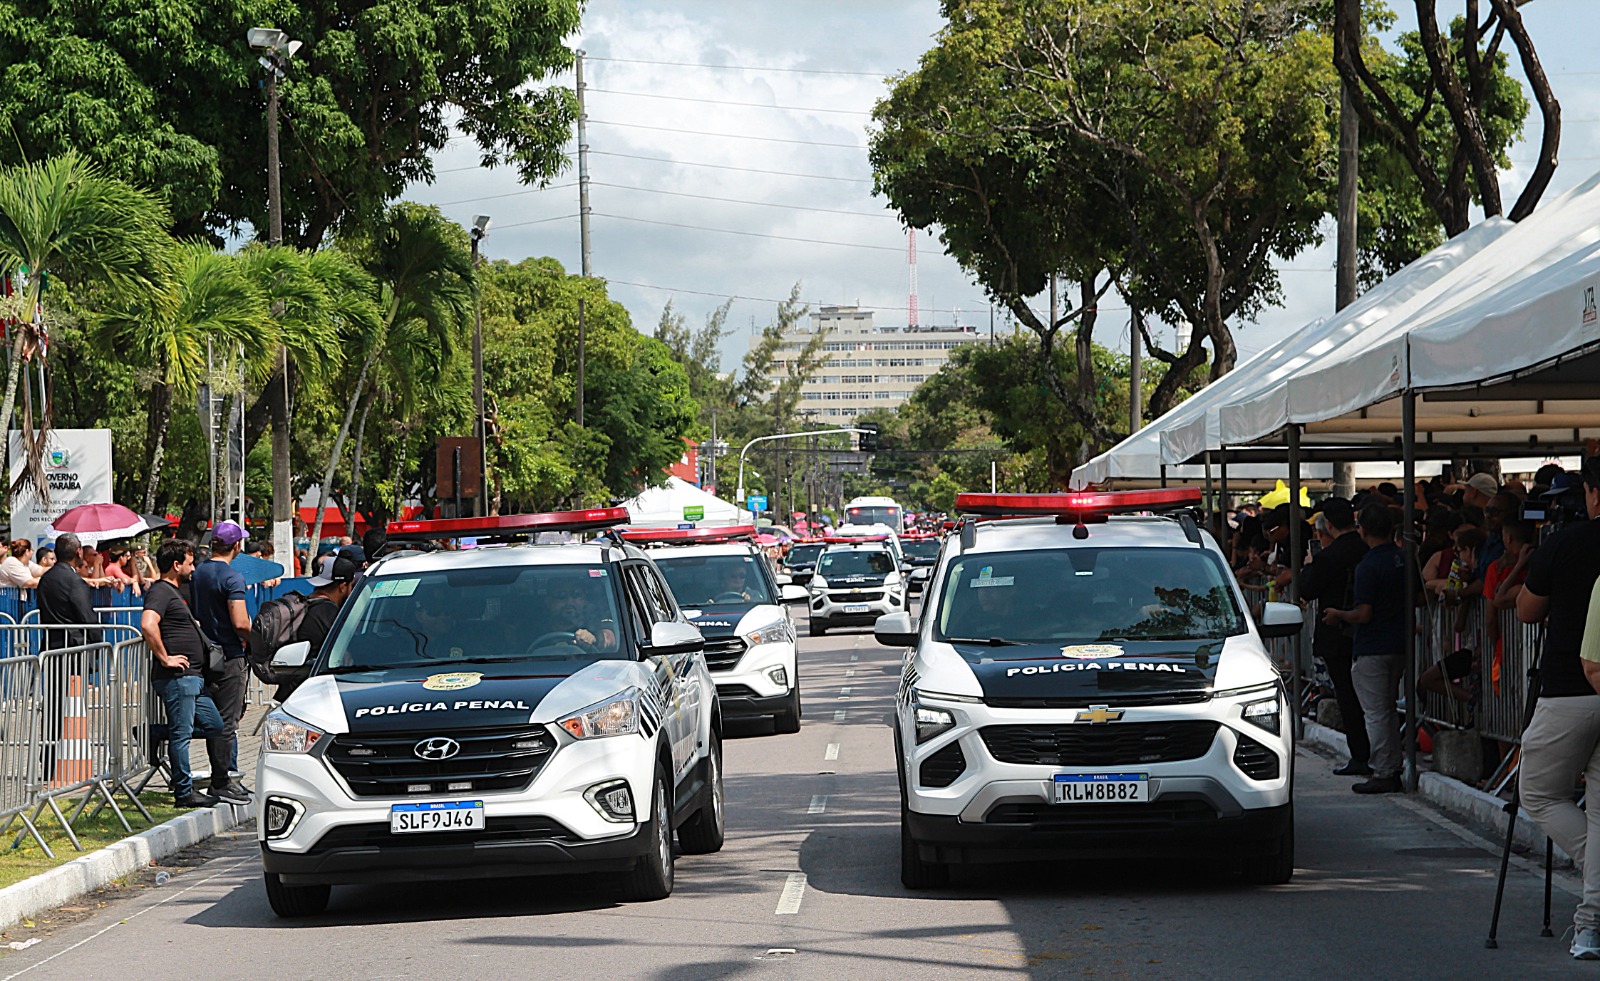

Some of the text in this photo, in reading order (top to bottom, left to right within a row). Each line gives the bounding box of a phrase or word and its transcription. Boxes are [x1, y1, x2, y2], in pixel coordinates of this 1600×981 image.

[45, 473, 78, 481] OVERNO
[1007, 663, 1186, 677] POLÍCIA PENAL
[355, 700, 530, 718] POLÍCIA PENAL
[1062, 783, 1138, 800] RLW8B82
[399, 810, 473, 830] SLF9J46
